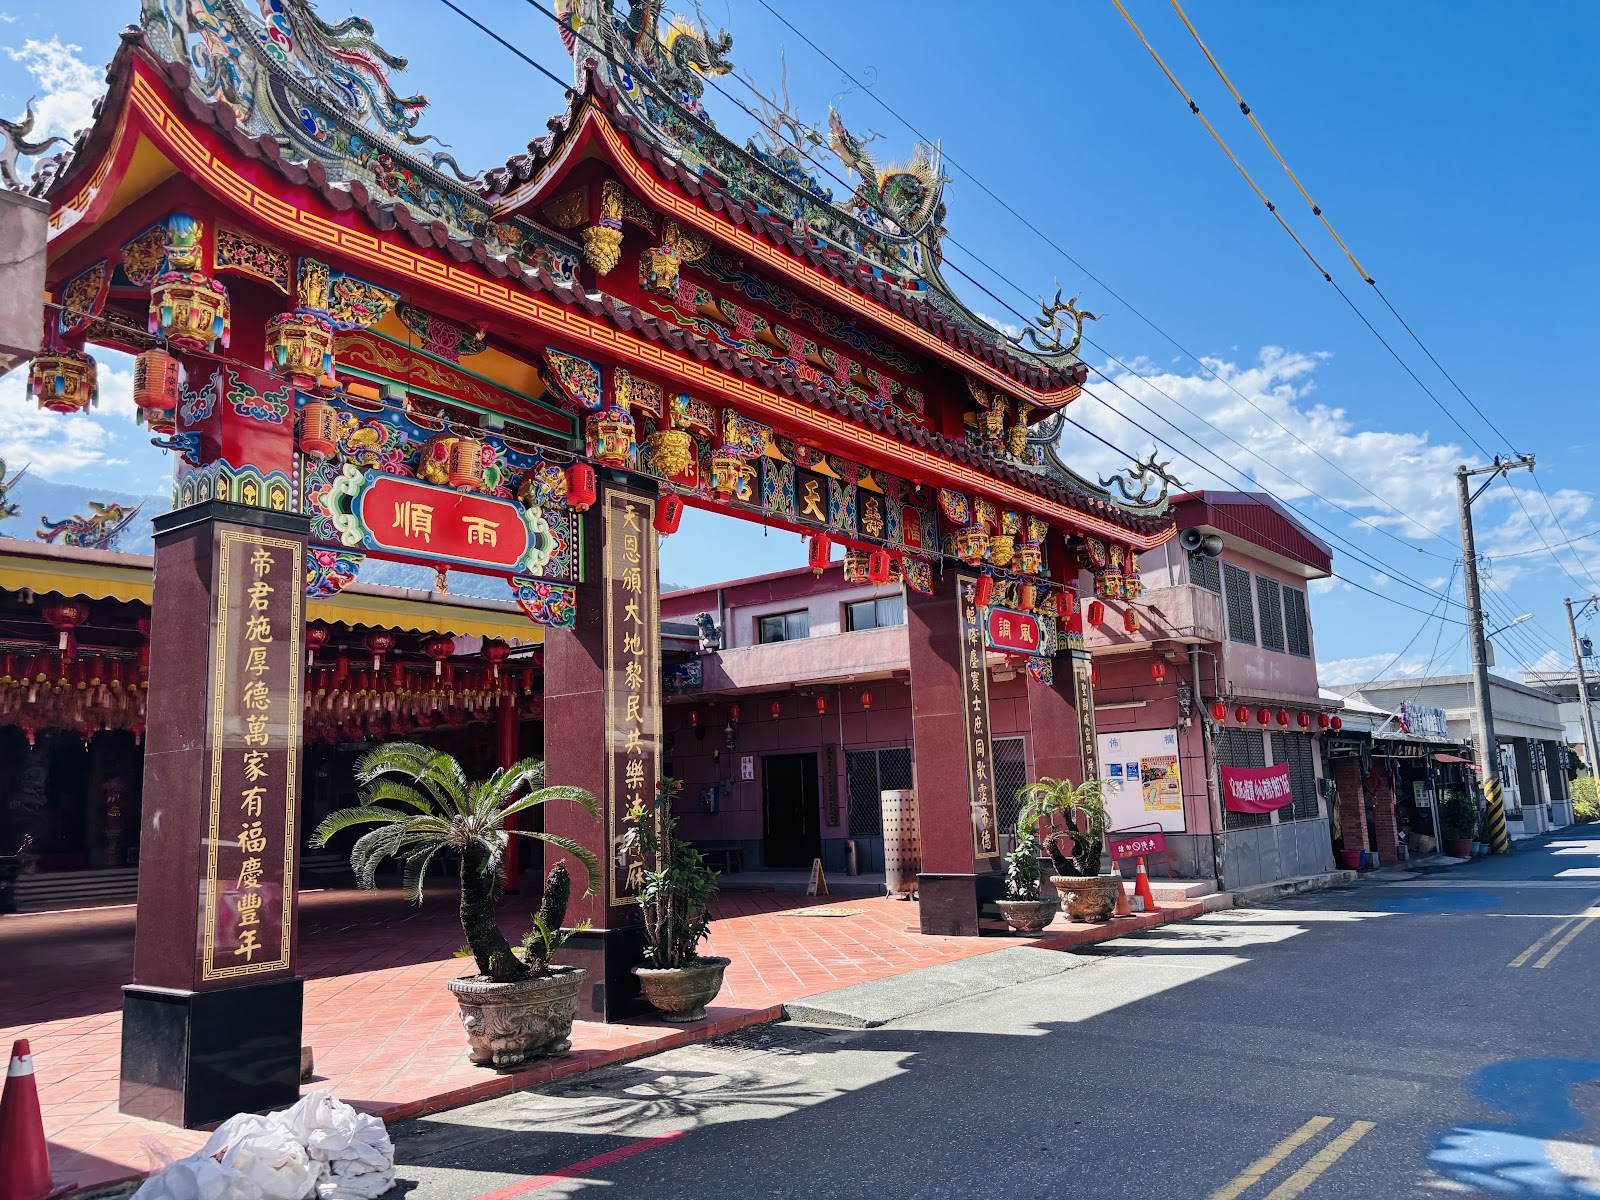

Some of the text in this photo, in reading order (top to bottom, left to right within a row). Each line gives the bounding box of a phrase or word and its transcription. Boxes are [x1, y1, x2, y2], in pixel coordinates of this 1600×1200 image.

[233, 548, 275, 963] 帝君施厚德萬家有福慶豐年
